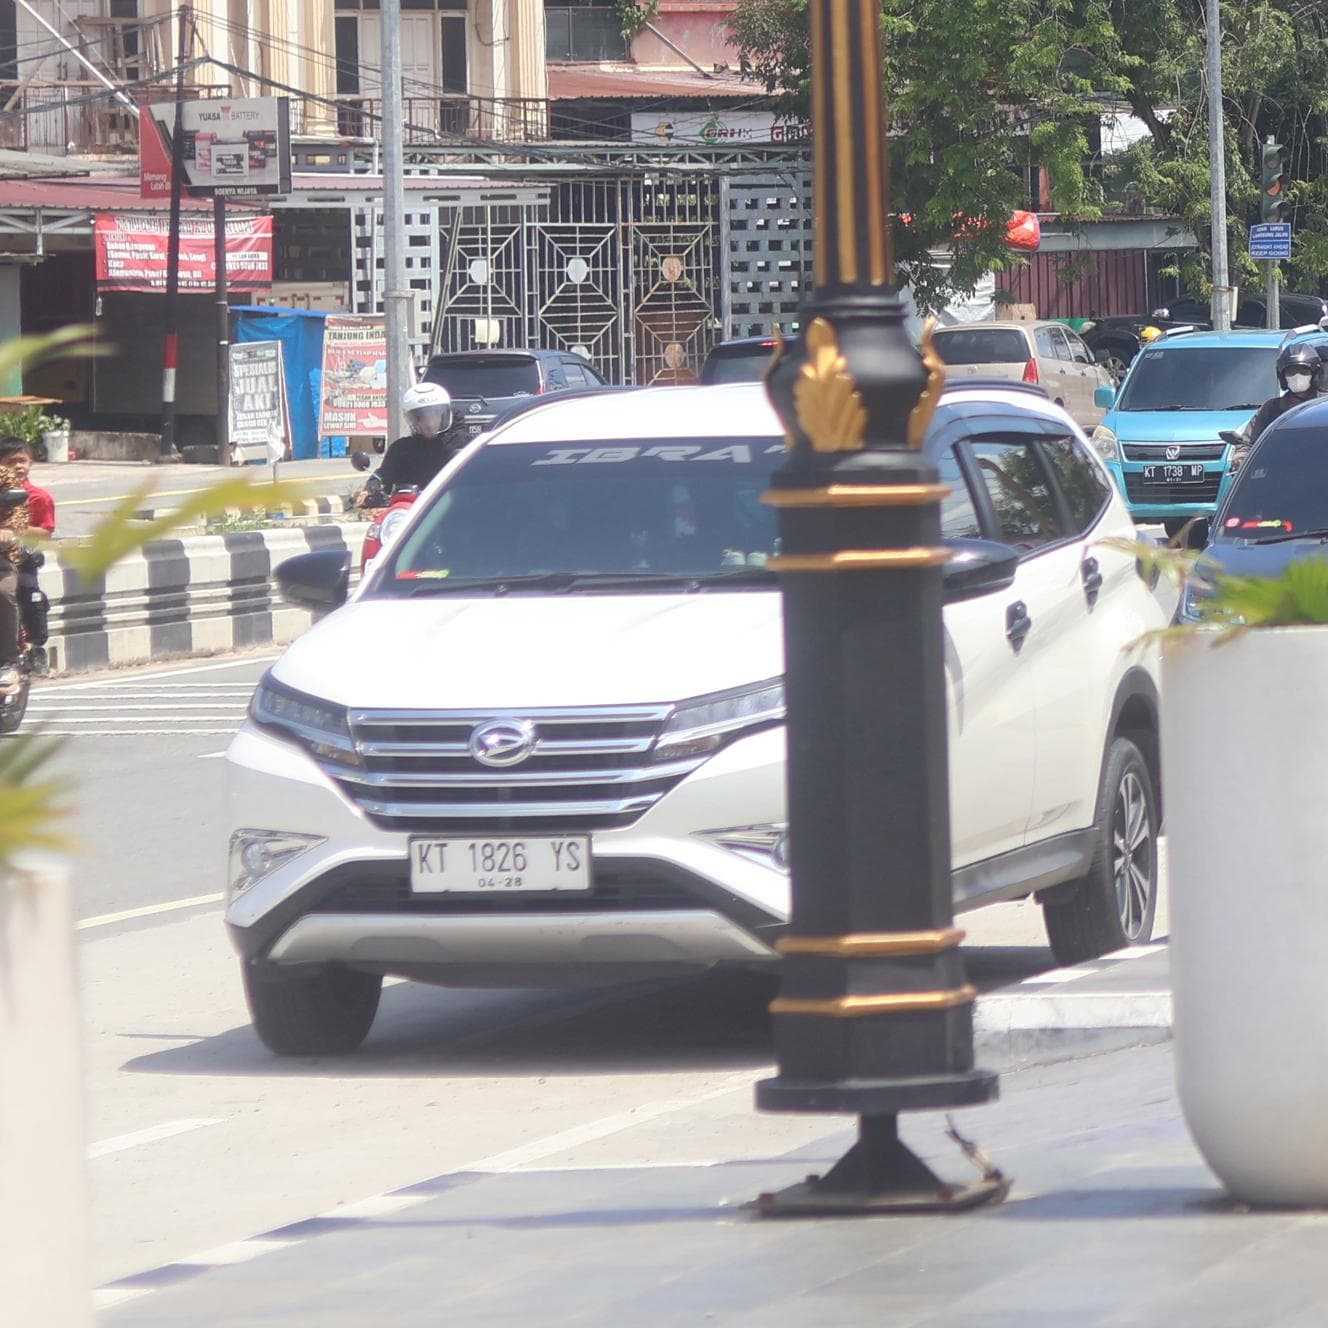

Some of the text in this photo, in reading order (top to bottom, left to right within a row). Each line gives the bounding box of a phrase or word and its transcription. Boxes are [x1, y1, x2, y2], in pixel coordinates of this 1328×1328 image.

[199, 111, 260, 121] YUASA BATTERY
[328, 330, 387, 341] TANJUNG INDA
[234, 362, 277, 378] SPESIALIS
[236, 375, 278, 395] JUAL
[242, 393, 273, 412] AKI
[324, 412, 356, 422] MASUK
[530, 445, 751, 466] IBRA
[1144, 466, 1156, 478] KT
[1163, 465, 1184, 478] 1738
[418, 841, 581, 873] KT 1826 YS
[478, 877, 523, 888] 04-28
